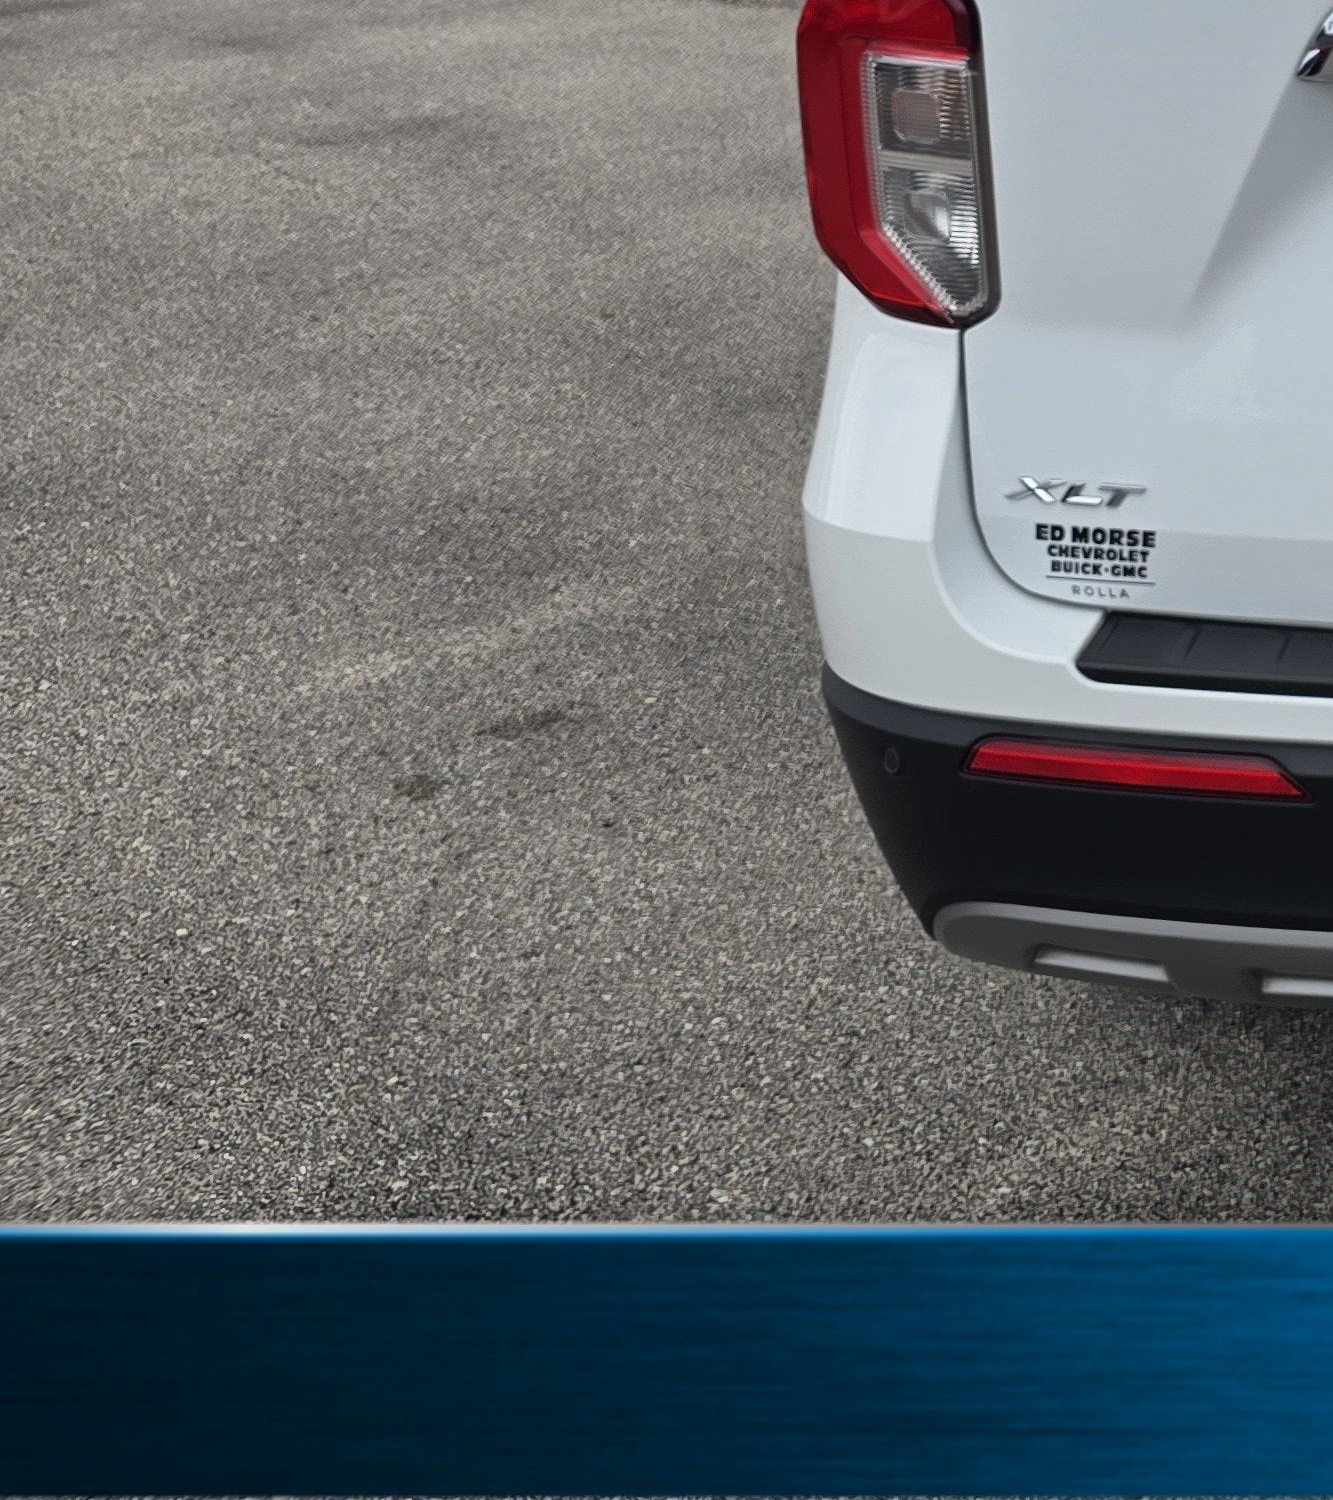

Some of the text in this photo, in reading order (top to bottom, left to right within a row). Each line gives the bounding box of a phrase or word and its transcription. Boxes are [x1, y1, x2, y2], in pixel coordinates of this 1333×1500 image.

[1004, 475, 1148, 510] XLT
[1035, 523, 1158, 548] ED MORSE
[1047, 544, 1151, 563] CHEVROLET
[1071, 584, 1130, 599] ROLLA
